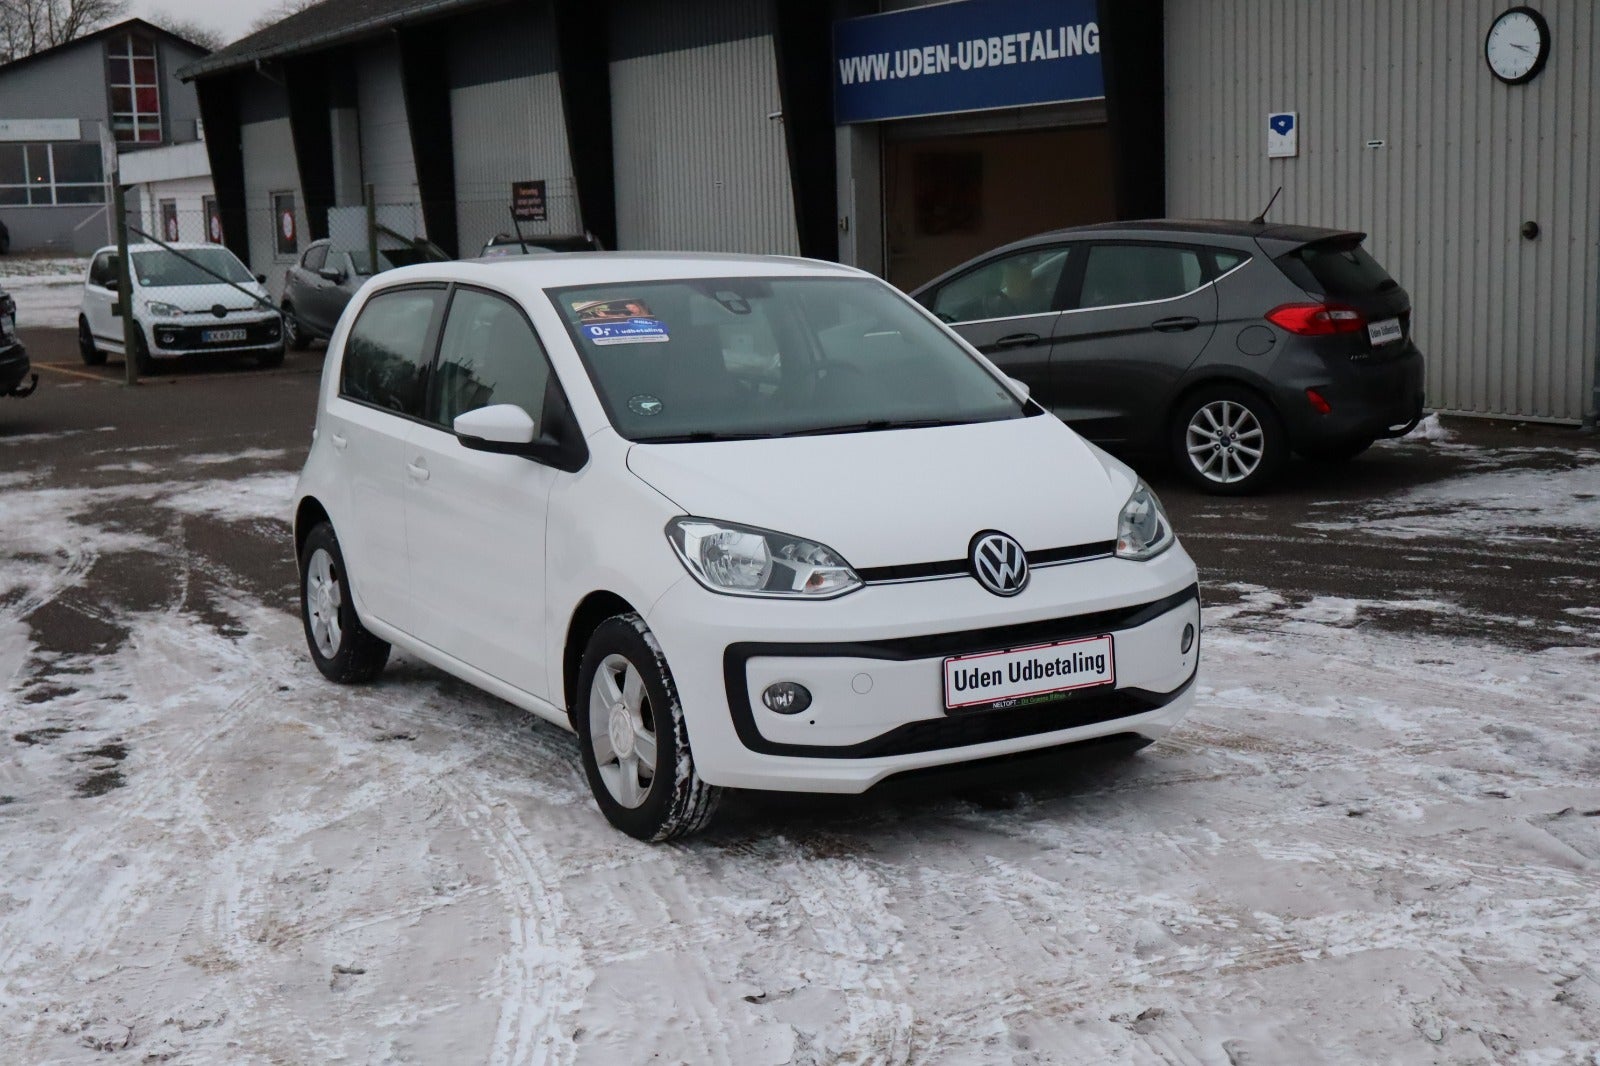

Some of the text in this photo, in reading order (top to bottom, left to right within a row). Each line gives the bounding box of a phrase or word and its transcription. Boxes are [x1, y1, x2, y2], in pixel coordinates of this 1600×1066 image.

[839, 22, 1100, 85] WWW.UDEN-UDBETALING
[954, 652, 1105, 691] Uden Udbetaling
[992, 700, 1017, 709] NELTOFT
